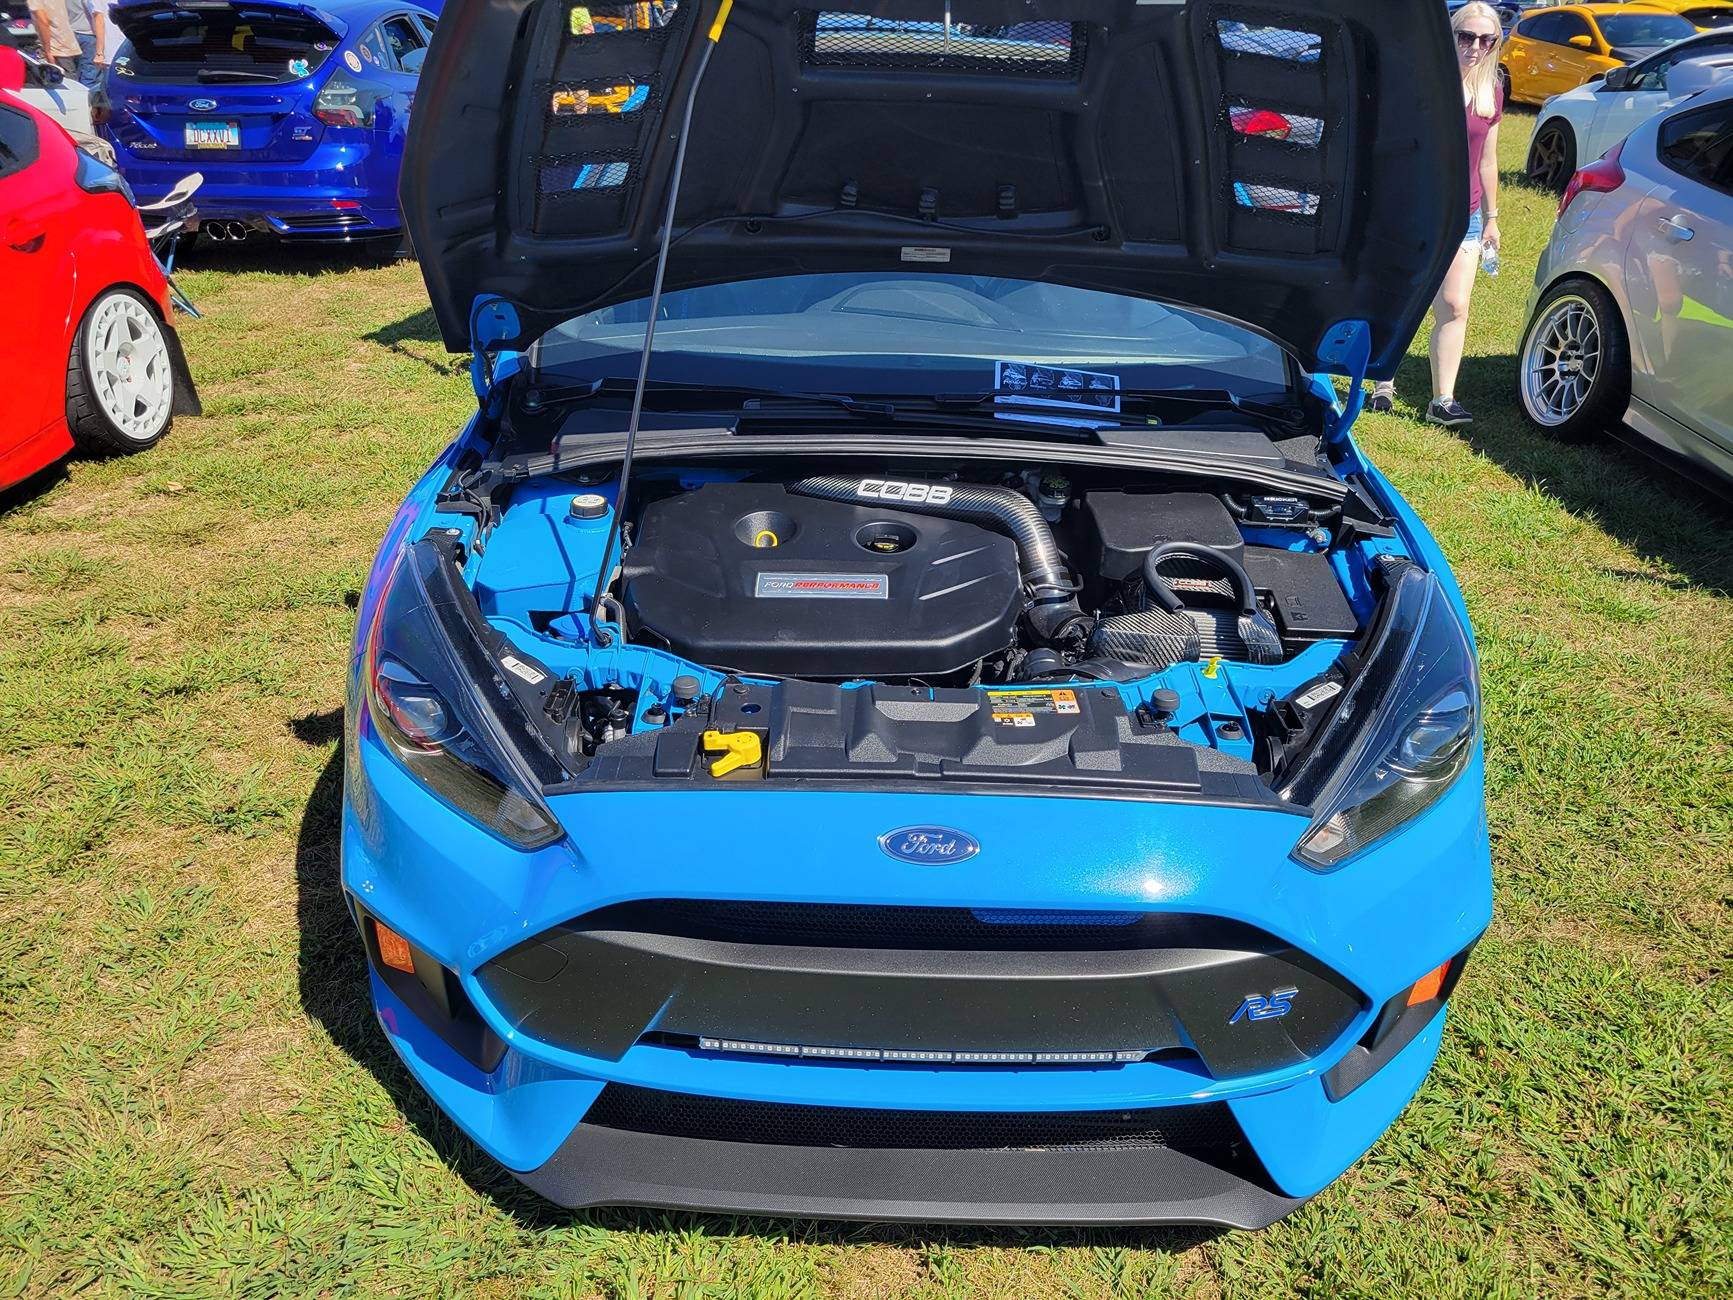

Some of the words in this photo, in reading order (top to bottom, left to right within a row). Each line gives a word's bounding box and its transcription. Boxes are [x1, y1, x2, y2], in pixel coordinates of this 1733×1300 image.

[858, 480, 953, 504] COBB
[763, 581, 795, 589] FORD
[794, 581, 881, 591] PERFORMANCE
[901, 832, 957, 855] Ford
[1228, 985, 1299, 1024] RS
